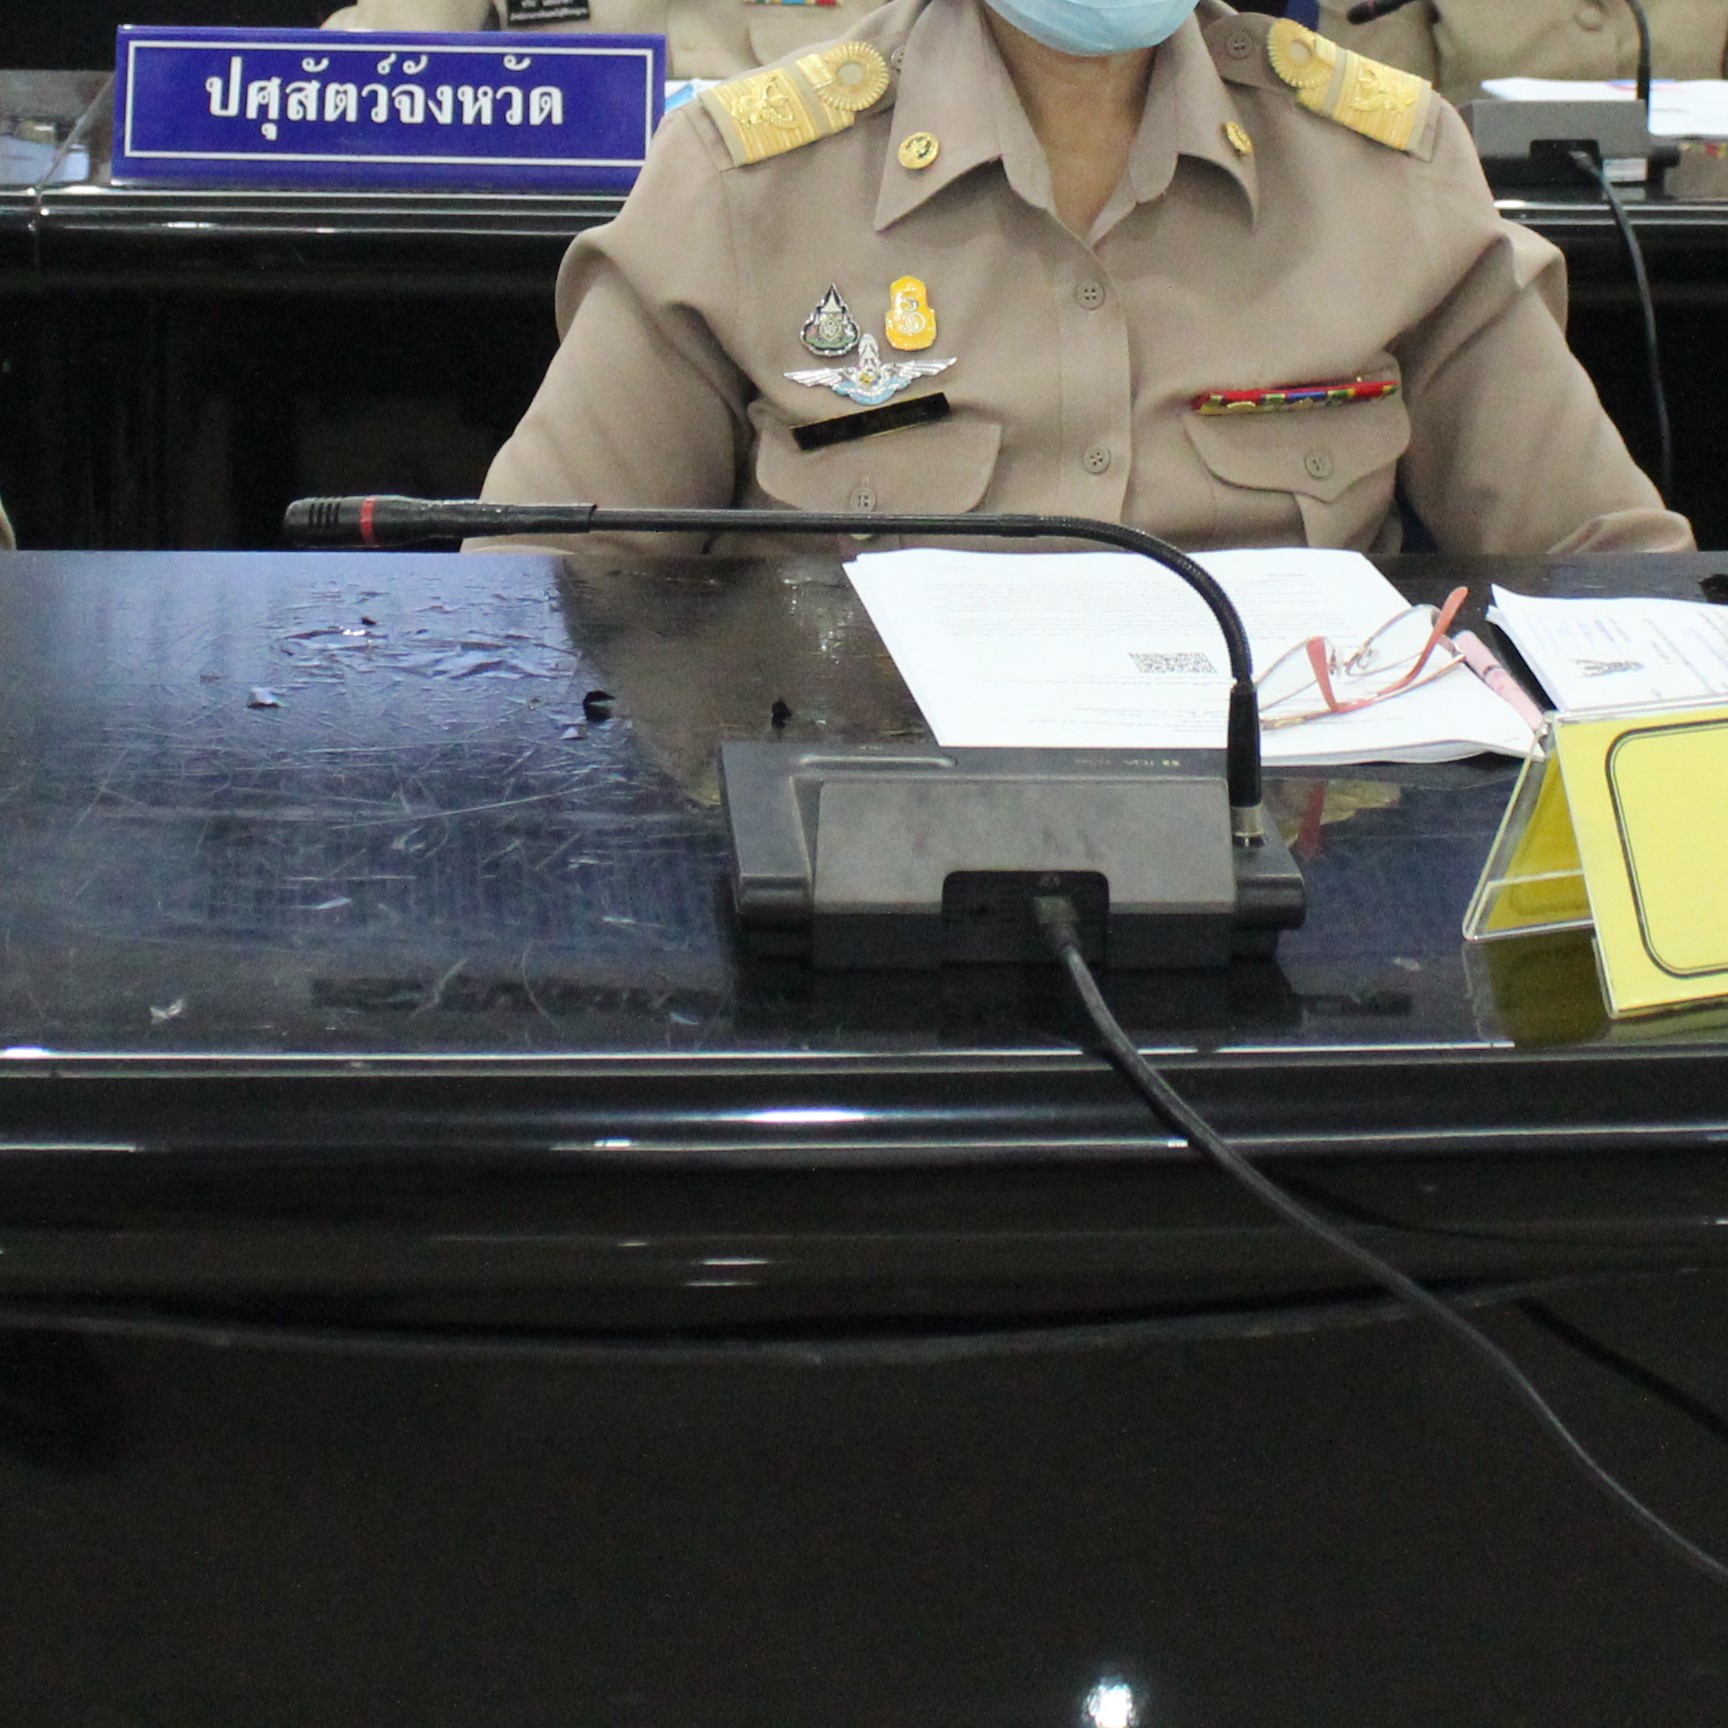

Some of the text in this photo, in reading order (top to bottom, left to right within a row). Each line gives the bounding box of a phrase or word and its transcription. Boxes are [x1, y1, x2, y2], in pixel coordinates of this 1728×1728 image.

[204, 52, 565, 141] ปศุสัตว์จังหวัด
